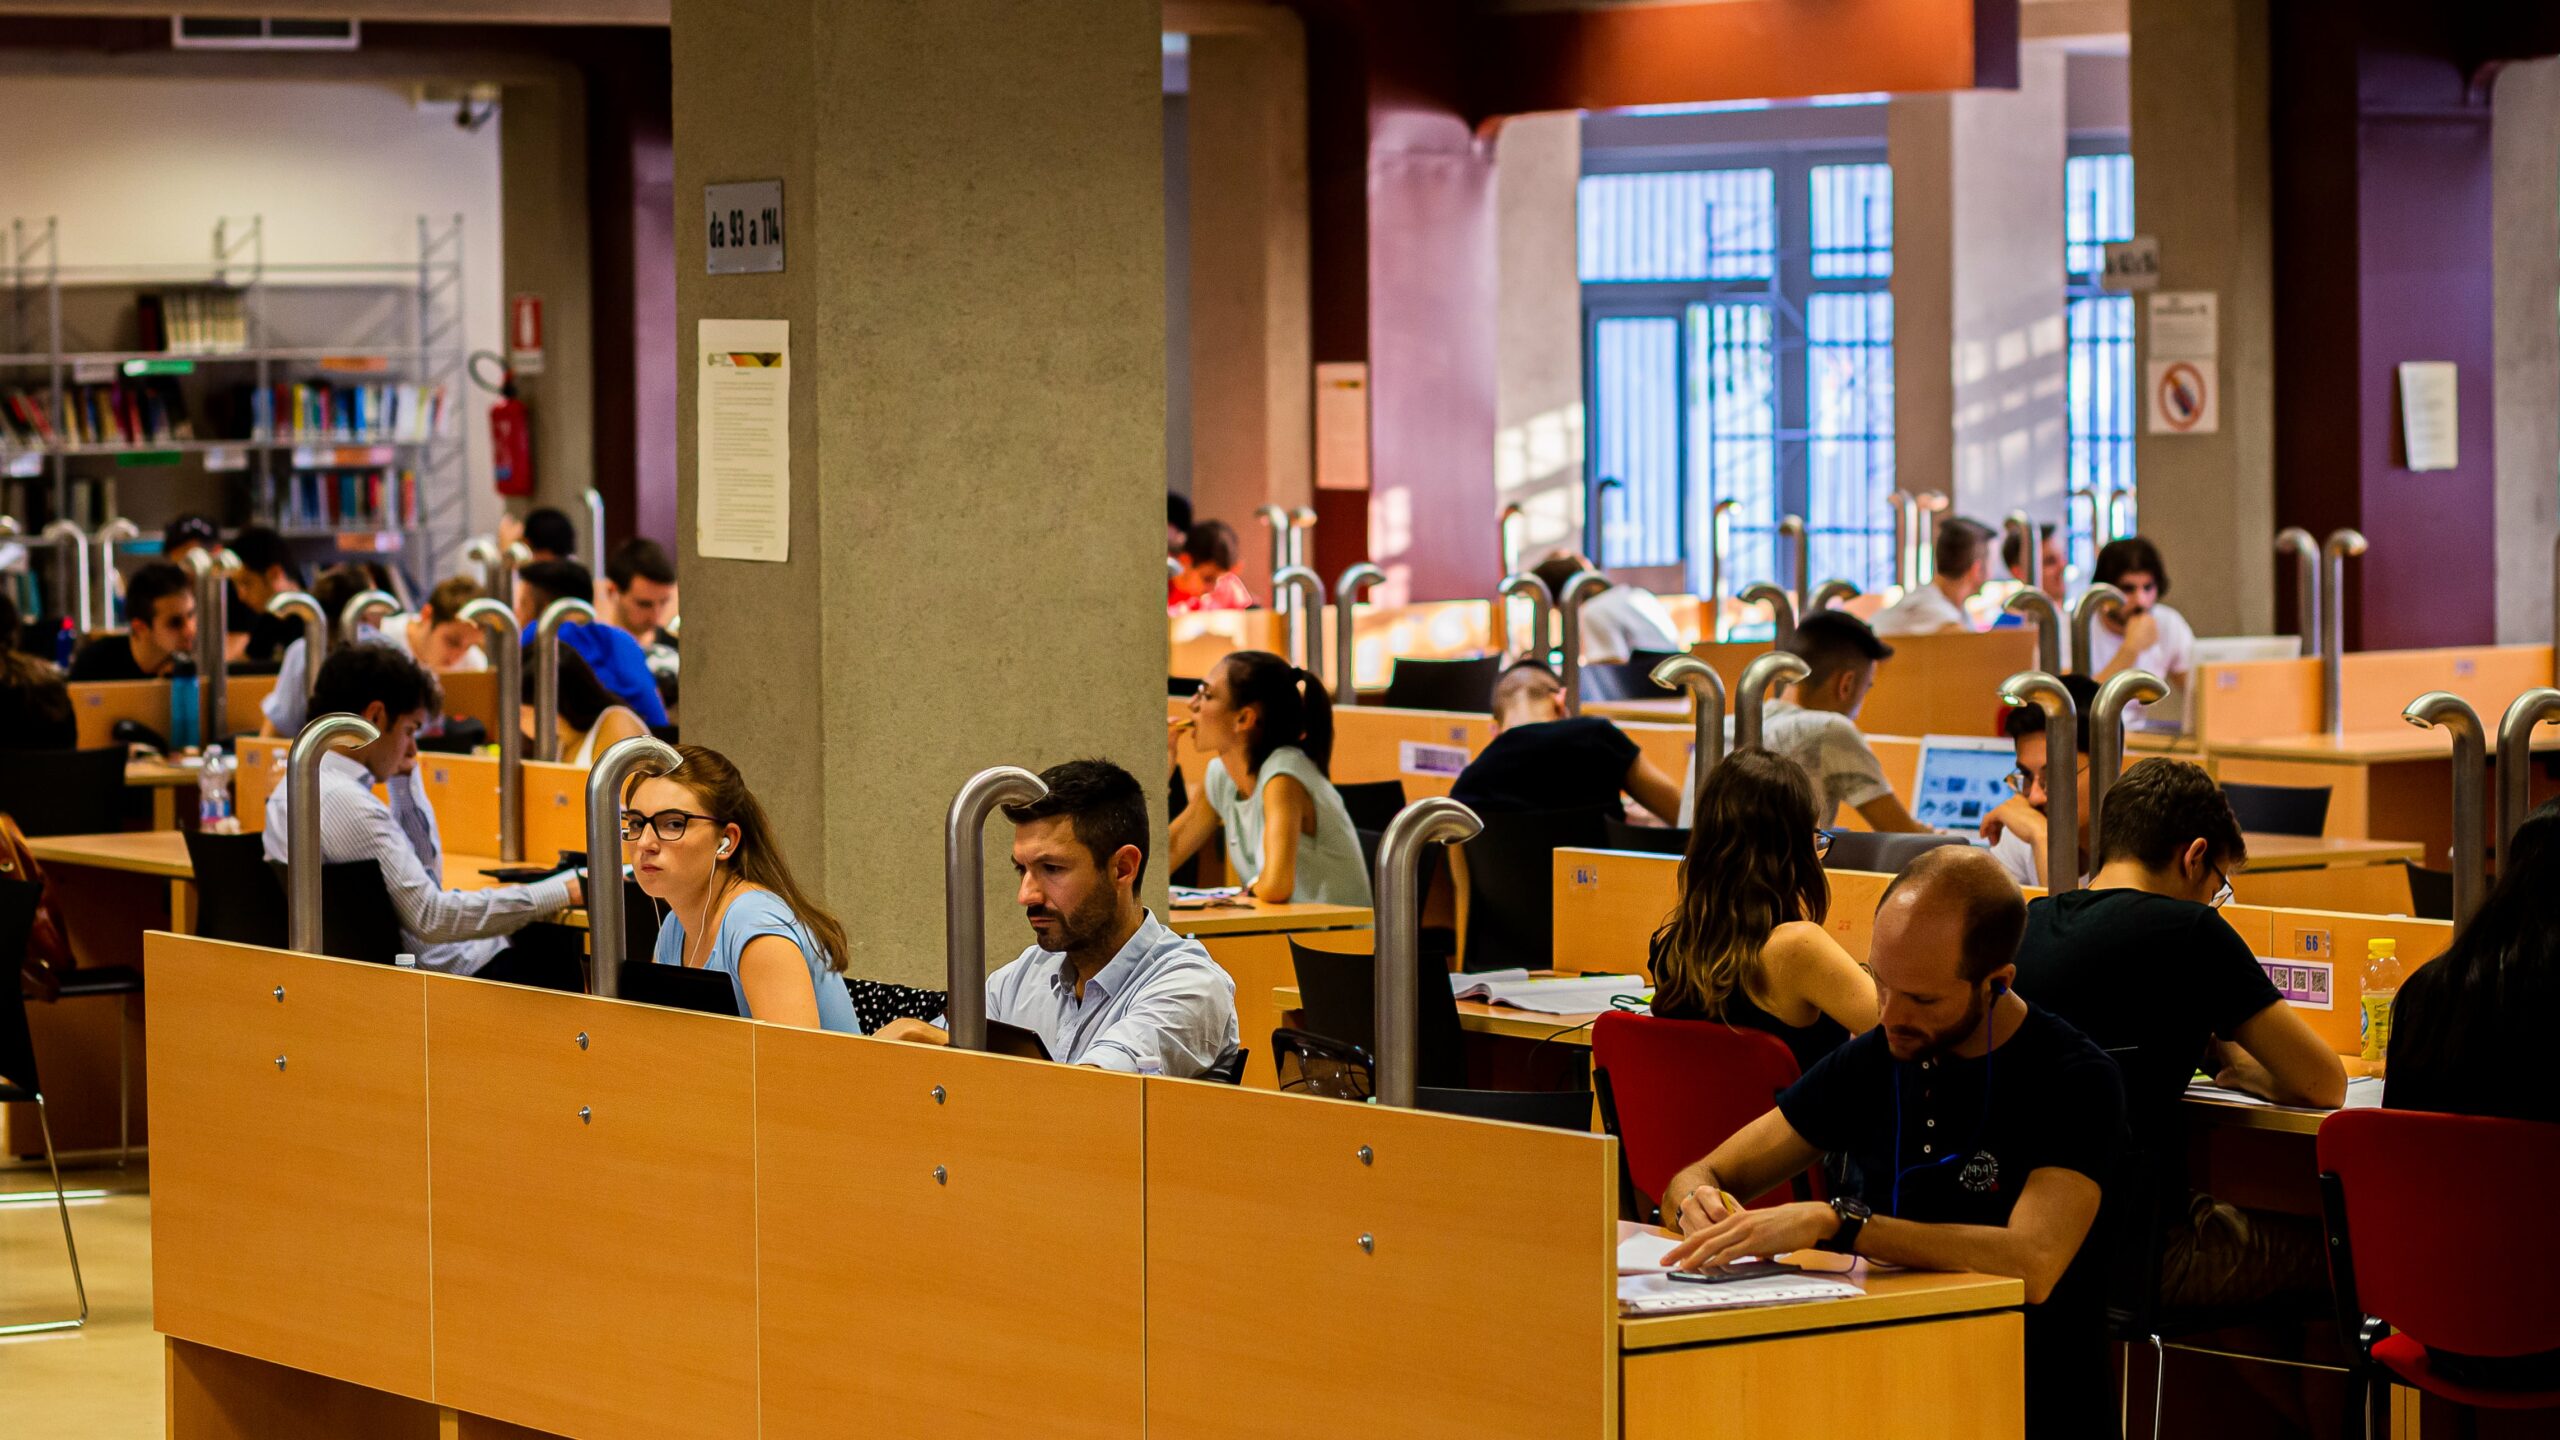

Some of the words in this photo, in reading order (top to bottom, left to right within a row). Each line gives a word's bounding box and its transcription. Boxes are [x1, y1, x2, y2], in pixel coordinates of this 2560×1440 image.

[709, 211, 724, 248] da
[729, 209, 744, 248] 93
[749, 219, 757, 246] a
[761, 207, 779, 246] 114
[2305, 934, 2318, 951] 66
